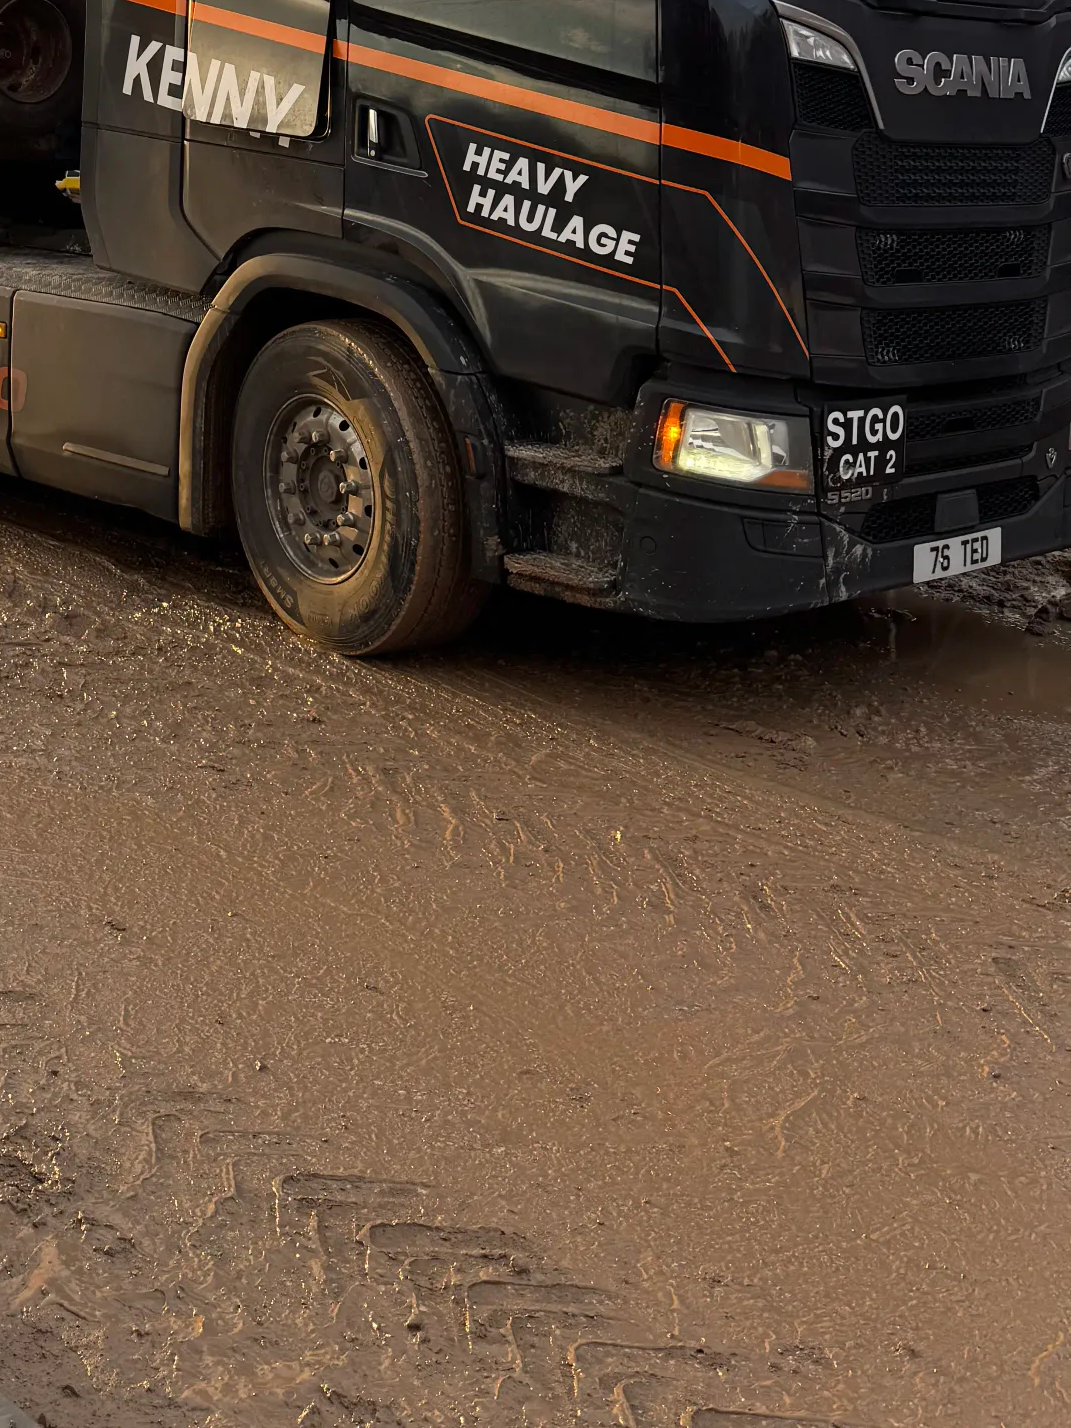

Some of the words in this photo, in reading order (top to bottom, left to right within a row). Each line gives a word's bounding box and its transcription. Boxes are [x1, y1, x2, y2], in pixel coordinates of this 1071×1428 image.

[122, 35, 306, 148] KENNY
[894, 49, 1032, 100] SCANIA
[462, 143, 589, 202] HEAVY
[466, 184, 641, 265] HAULAGE
[826, 404, 904, 448] STGO
[839, 450, 879, 480] CAT
[885, 449, 896, 474] 2
[961, 535, 989, 567] TED
